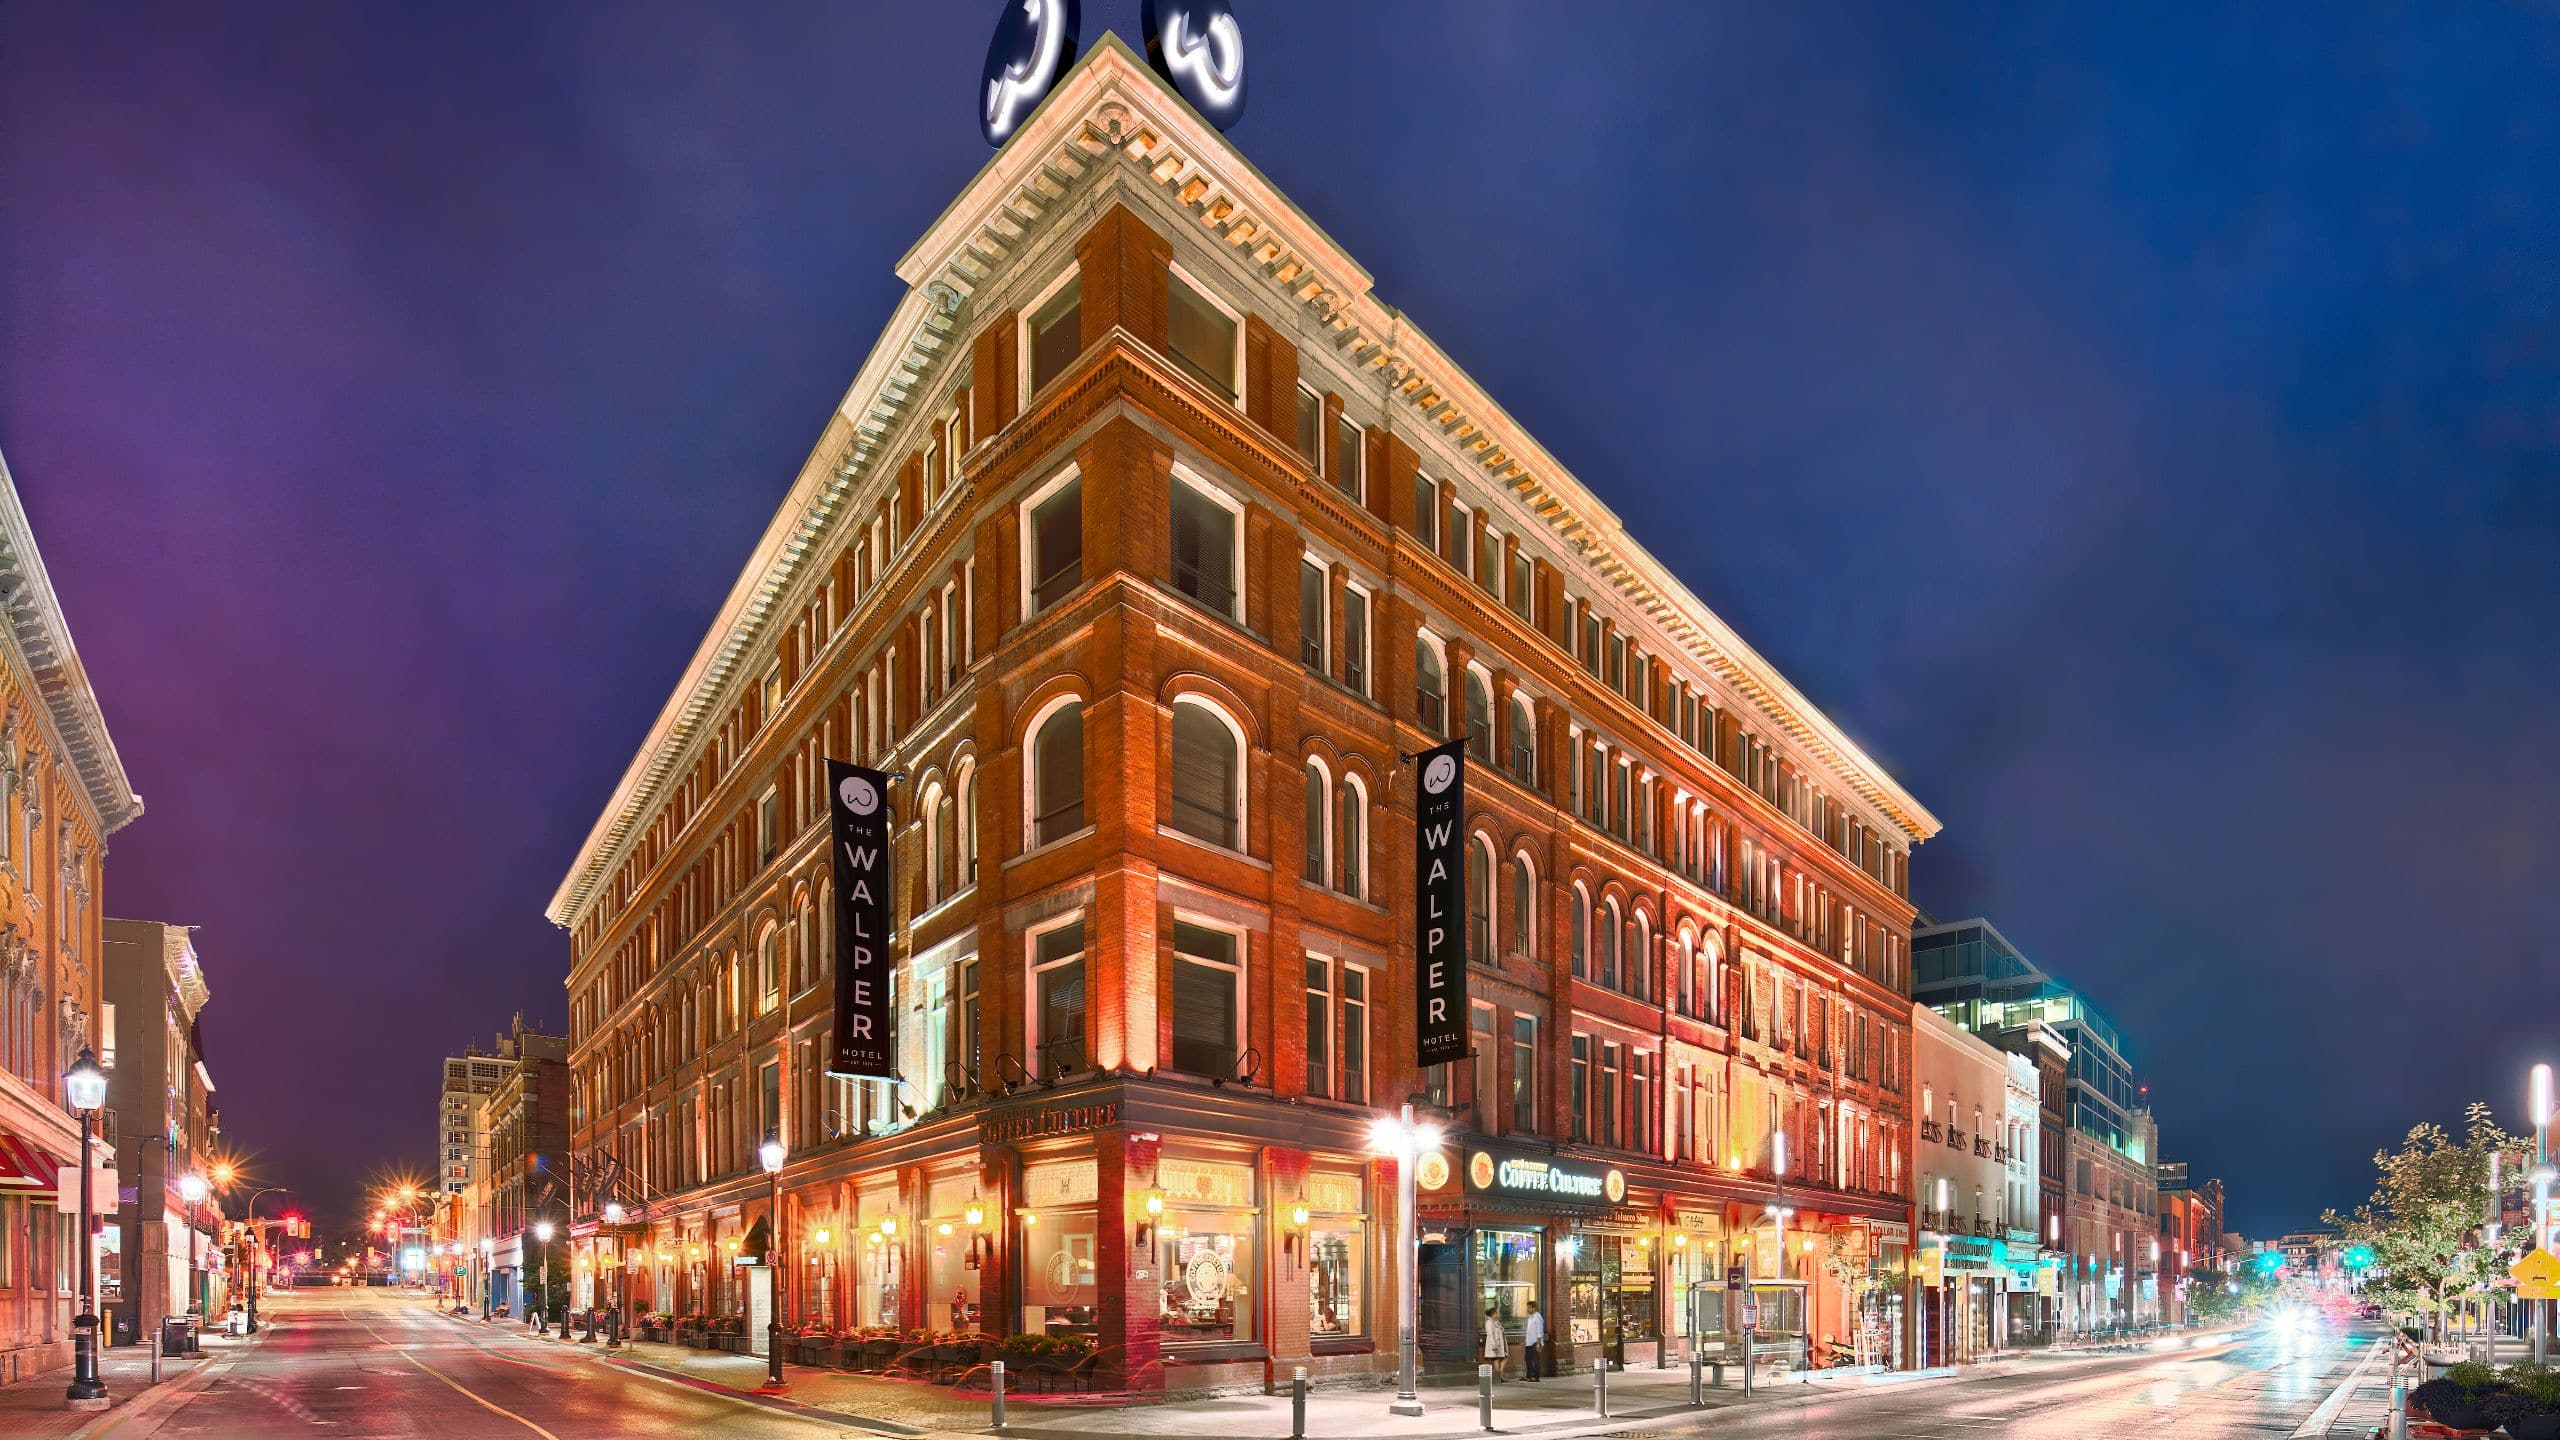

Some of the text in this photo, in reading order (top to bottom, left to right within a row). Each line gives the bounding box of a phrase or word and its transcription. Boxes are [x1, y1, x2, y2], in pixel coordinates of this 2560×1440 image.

[1429, 801, 1450, 815] THE
[848, 824, 872, 838] THE
[1424, 819, 1453, 1025] WALPER
[844, 841, 878, 1040] WALPER
[1423, 1033, 1458, 1046] HOTEL
[842, 1048, 882, 1060] HOTEL
[1499, 1160, 1549, 1190] COFFEE
[1549, 1168, 1602, 1195] CULTURE
[1615, 1211, 1636, 1222] Tobacco
[1636, 1212, 1650, 1224] Shop
